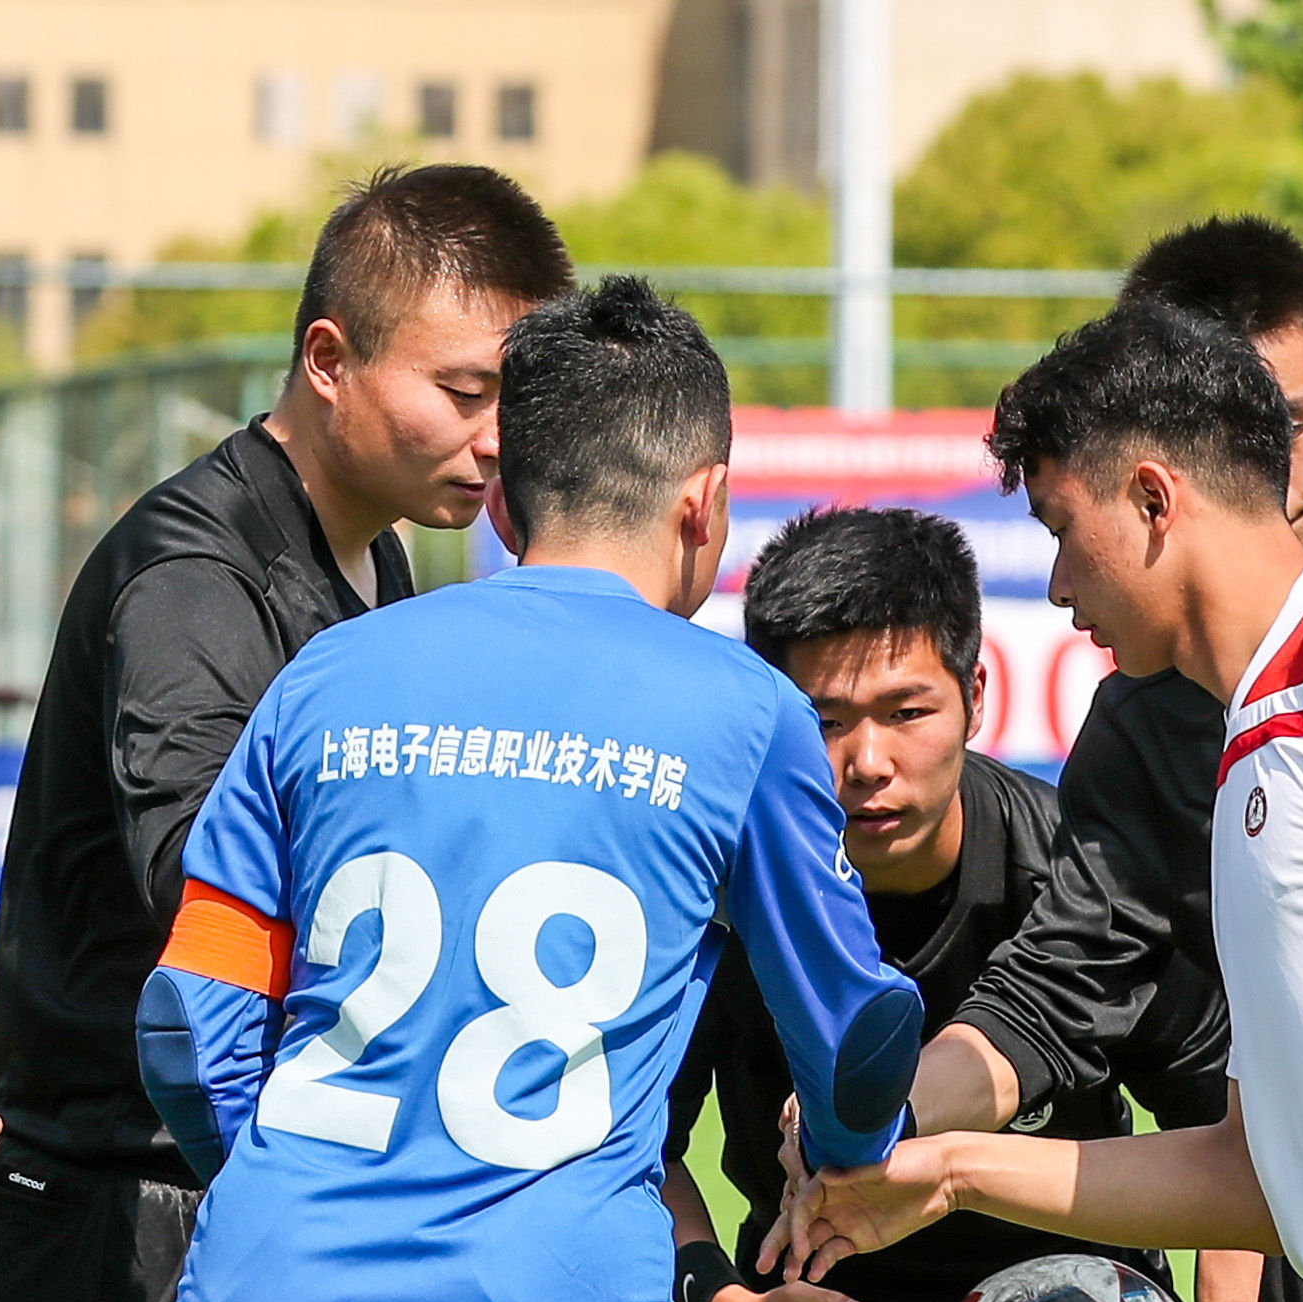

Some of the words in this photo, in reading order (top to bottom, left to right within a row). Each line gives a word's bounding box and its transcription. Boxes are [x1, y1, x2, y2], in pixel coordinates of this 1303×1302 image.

[316, 722, 688, 811] 上海电子信息职业技术学院
[256, 851, 648, 1171] 28
